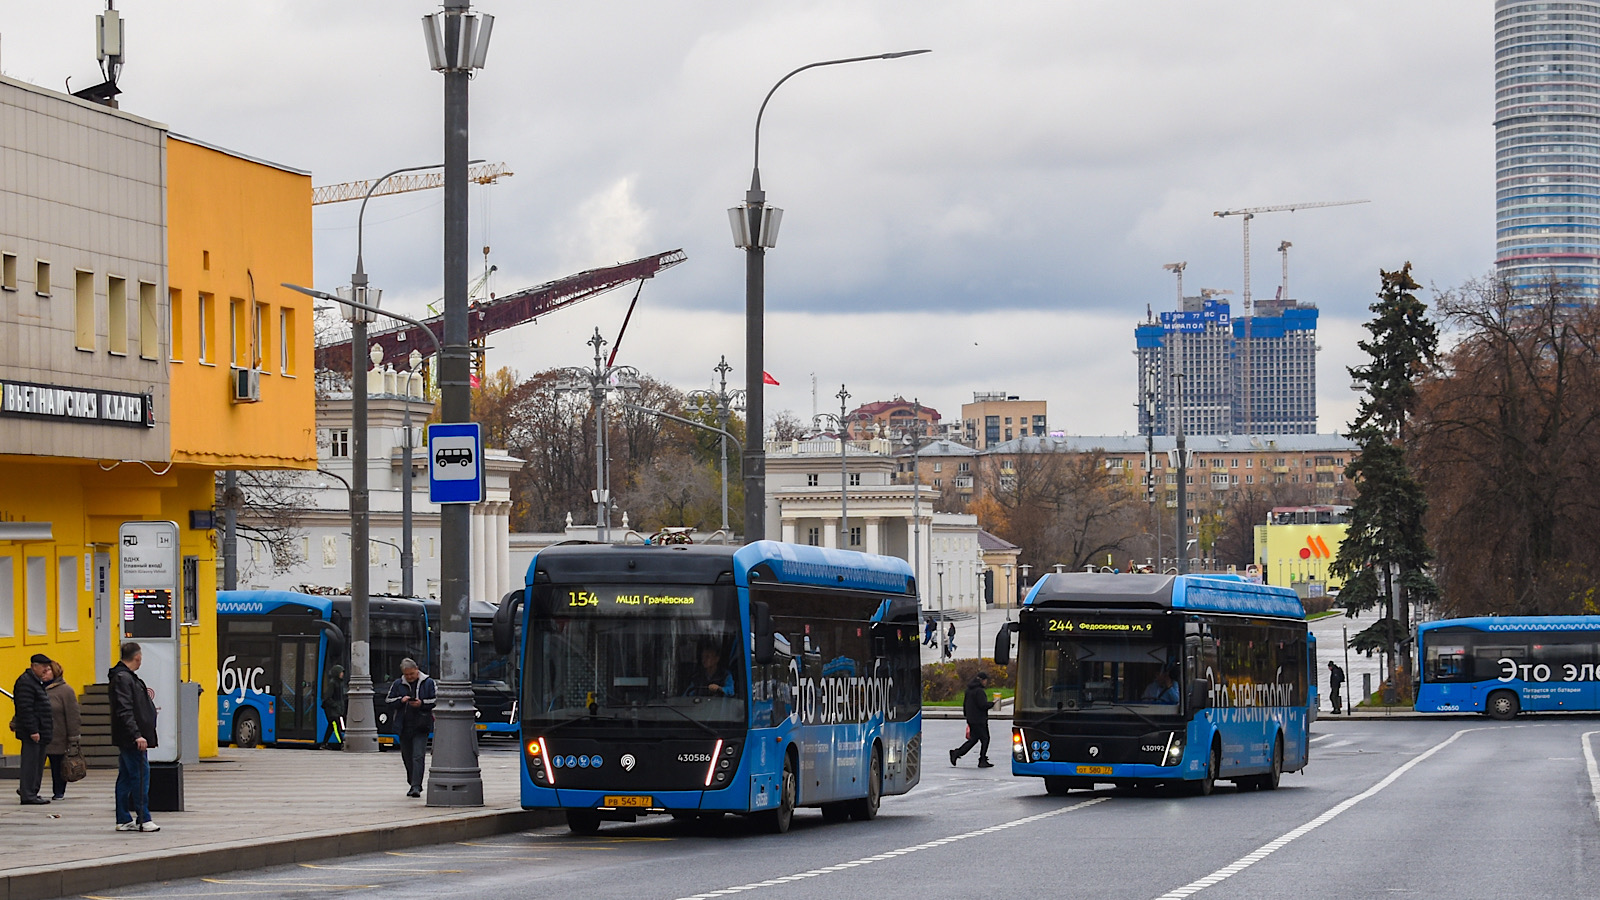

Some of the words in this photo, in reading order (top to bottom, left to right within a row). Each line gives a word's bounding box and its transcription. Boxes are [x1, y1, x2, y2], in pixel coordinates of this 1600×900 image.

[5, 384, 98, 419] ВЬЕТНАМСКАЯ
[102, 394, 142, 422] КУХНЯ
[569, 592, 599, 607] 154
[616, 595, 641, 605] МЦД
[643, 595, 694, 605] Грачёвская
[1048, 619, 1074, 631] 244
[1079, 622, 1130, 631] Федоскинская
[1146, 623, 1152, 631] 9
[217, 655, 270, 704] бус.
[1497, 657, 1551, 682] Это
[789, 658, 816, 724] Это
[820, 658, 897, 735] электробус.
[1206, 666, 1229, 723] Это
[1231, 666, 1297, 735] электробус.
[677, 754, 711, 762] 430586
[621, 797, 637, 806] 545
